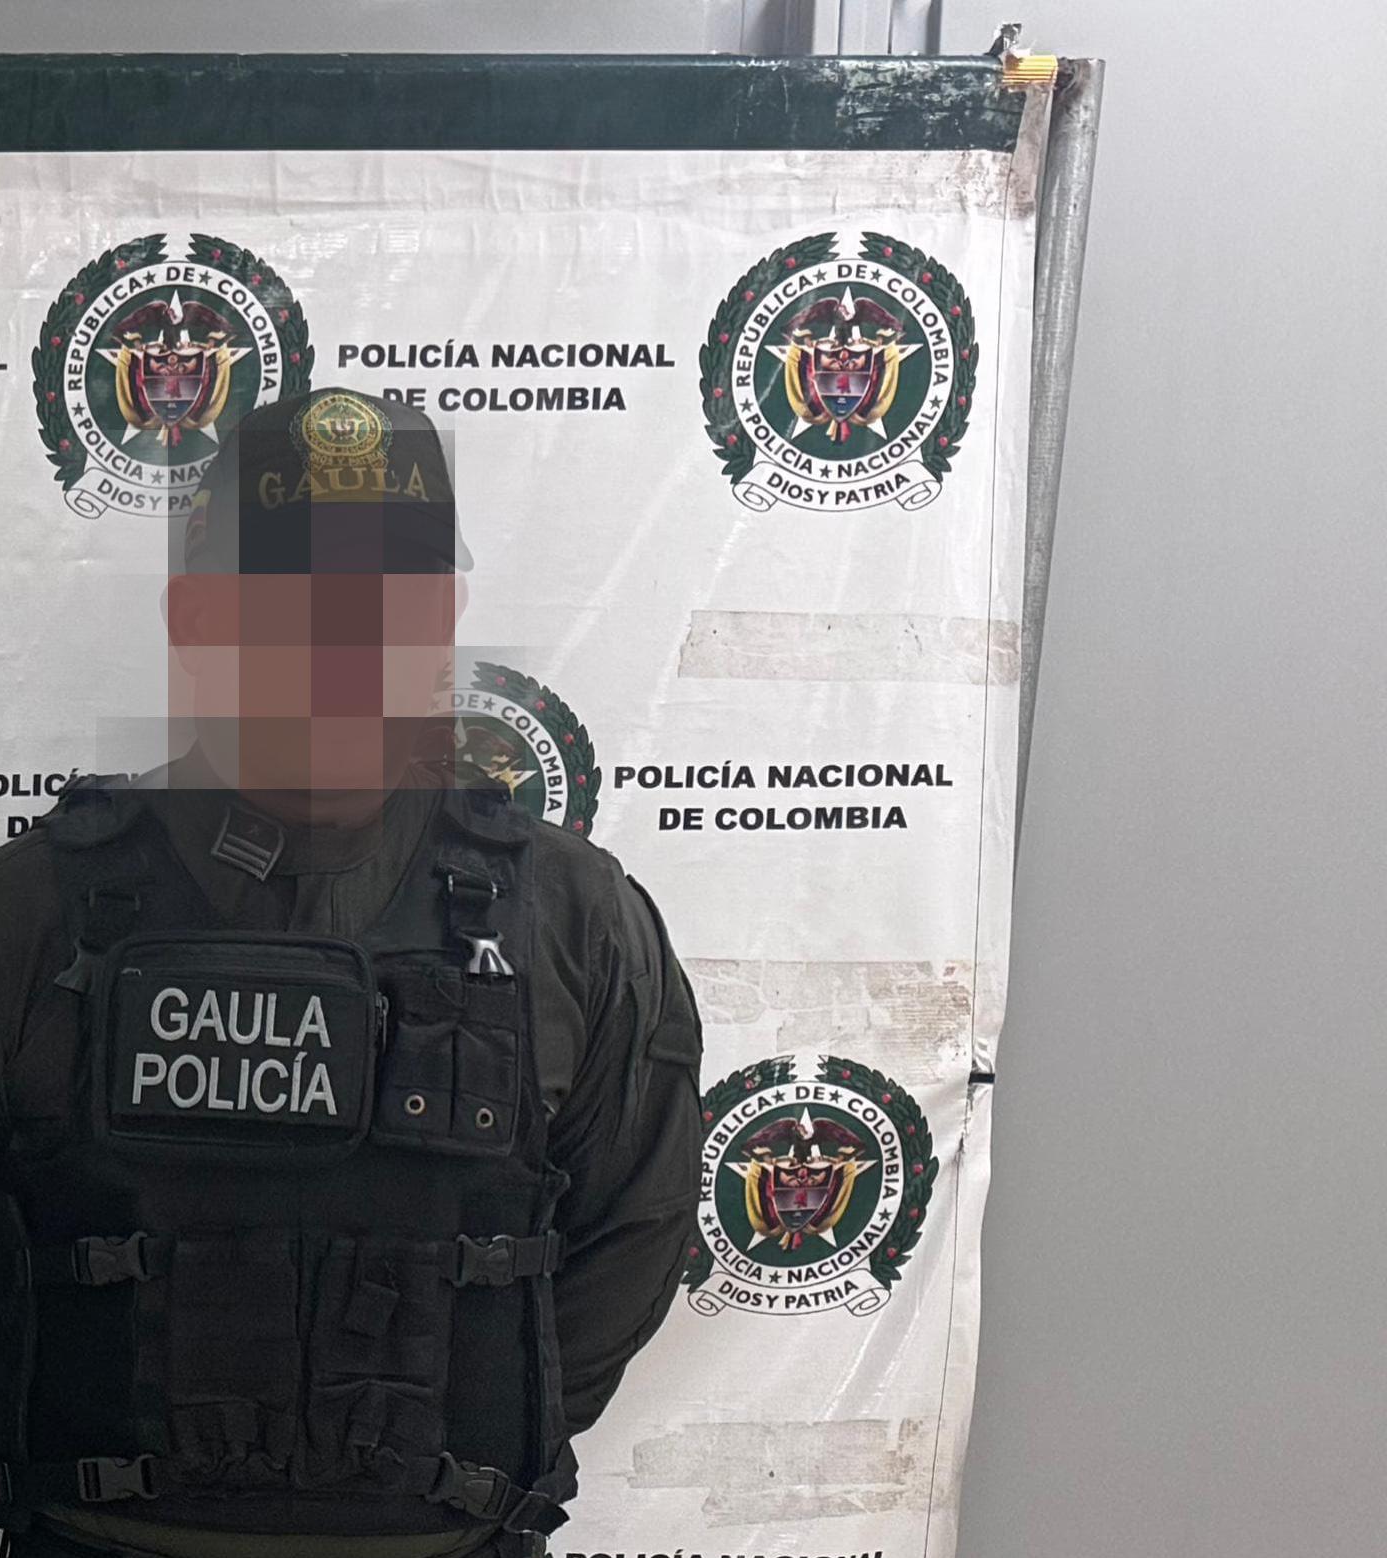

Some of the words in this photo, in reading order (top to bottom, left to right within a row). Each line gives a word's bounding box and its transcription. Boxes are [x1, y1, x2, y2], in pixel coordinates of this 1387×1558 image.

[167, 267, 194, 281] DE
[218, 281, 277, 390] COLOMBIA
[339, 339, 479, 368] POLICÍA
[492, 344, 675, 367] NACIONAL
[838, 265, 866, 278] DE
[889, 278, 948, 385] COLOMBIA
[383, 388, 429, 412] DE
[438, 388, 626, 411] COLOMBIA
[839, 413, 936, 477] NACIONAL
[258, 461, 430, 509] GAULA
[836, 474, 909, 504] PATRIA
[502, 708, 562, 811] COLOMBIA
[615, 761, 755, 788] POLICÍA
[768, 764, 952, 788] NACIONAL
[659, 808, 703, 830] DE
[715, 807, 907, 830] COLOMBIA
[150, 987, 331, 1048] GAULA
[131, 1051, 338, 1115] POLICÍA
[796, 1086, 825, 1100] DE
[848, 1099, 898, 1199] COLOMBIA
[787, 1224, 886, 1284] NACIONAL
[786, 1280, 859, 1308] PATRIA
